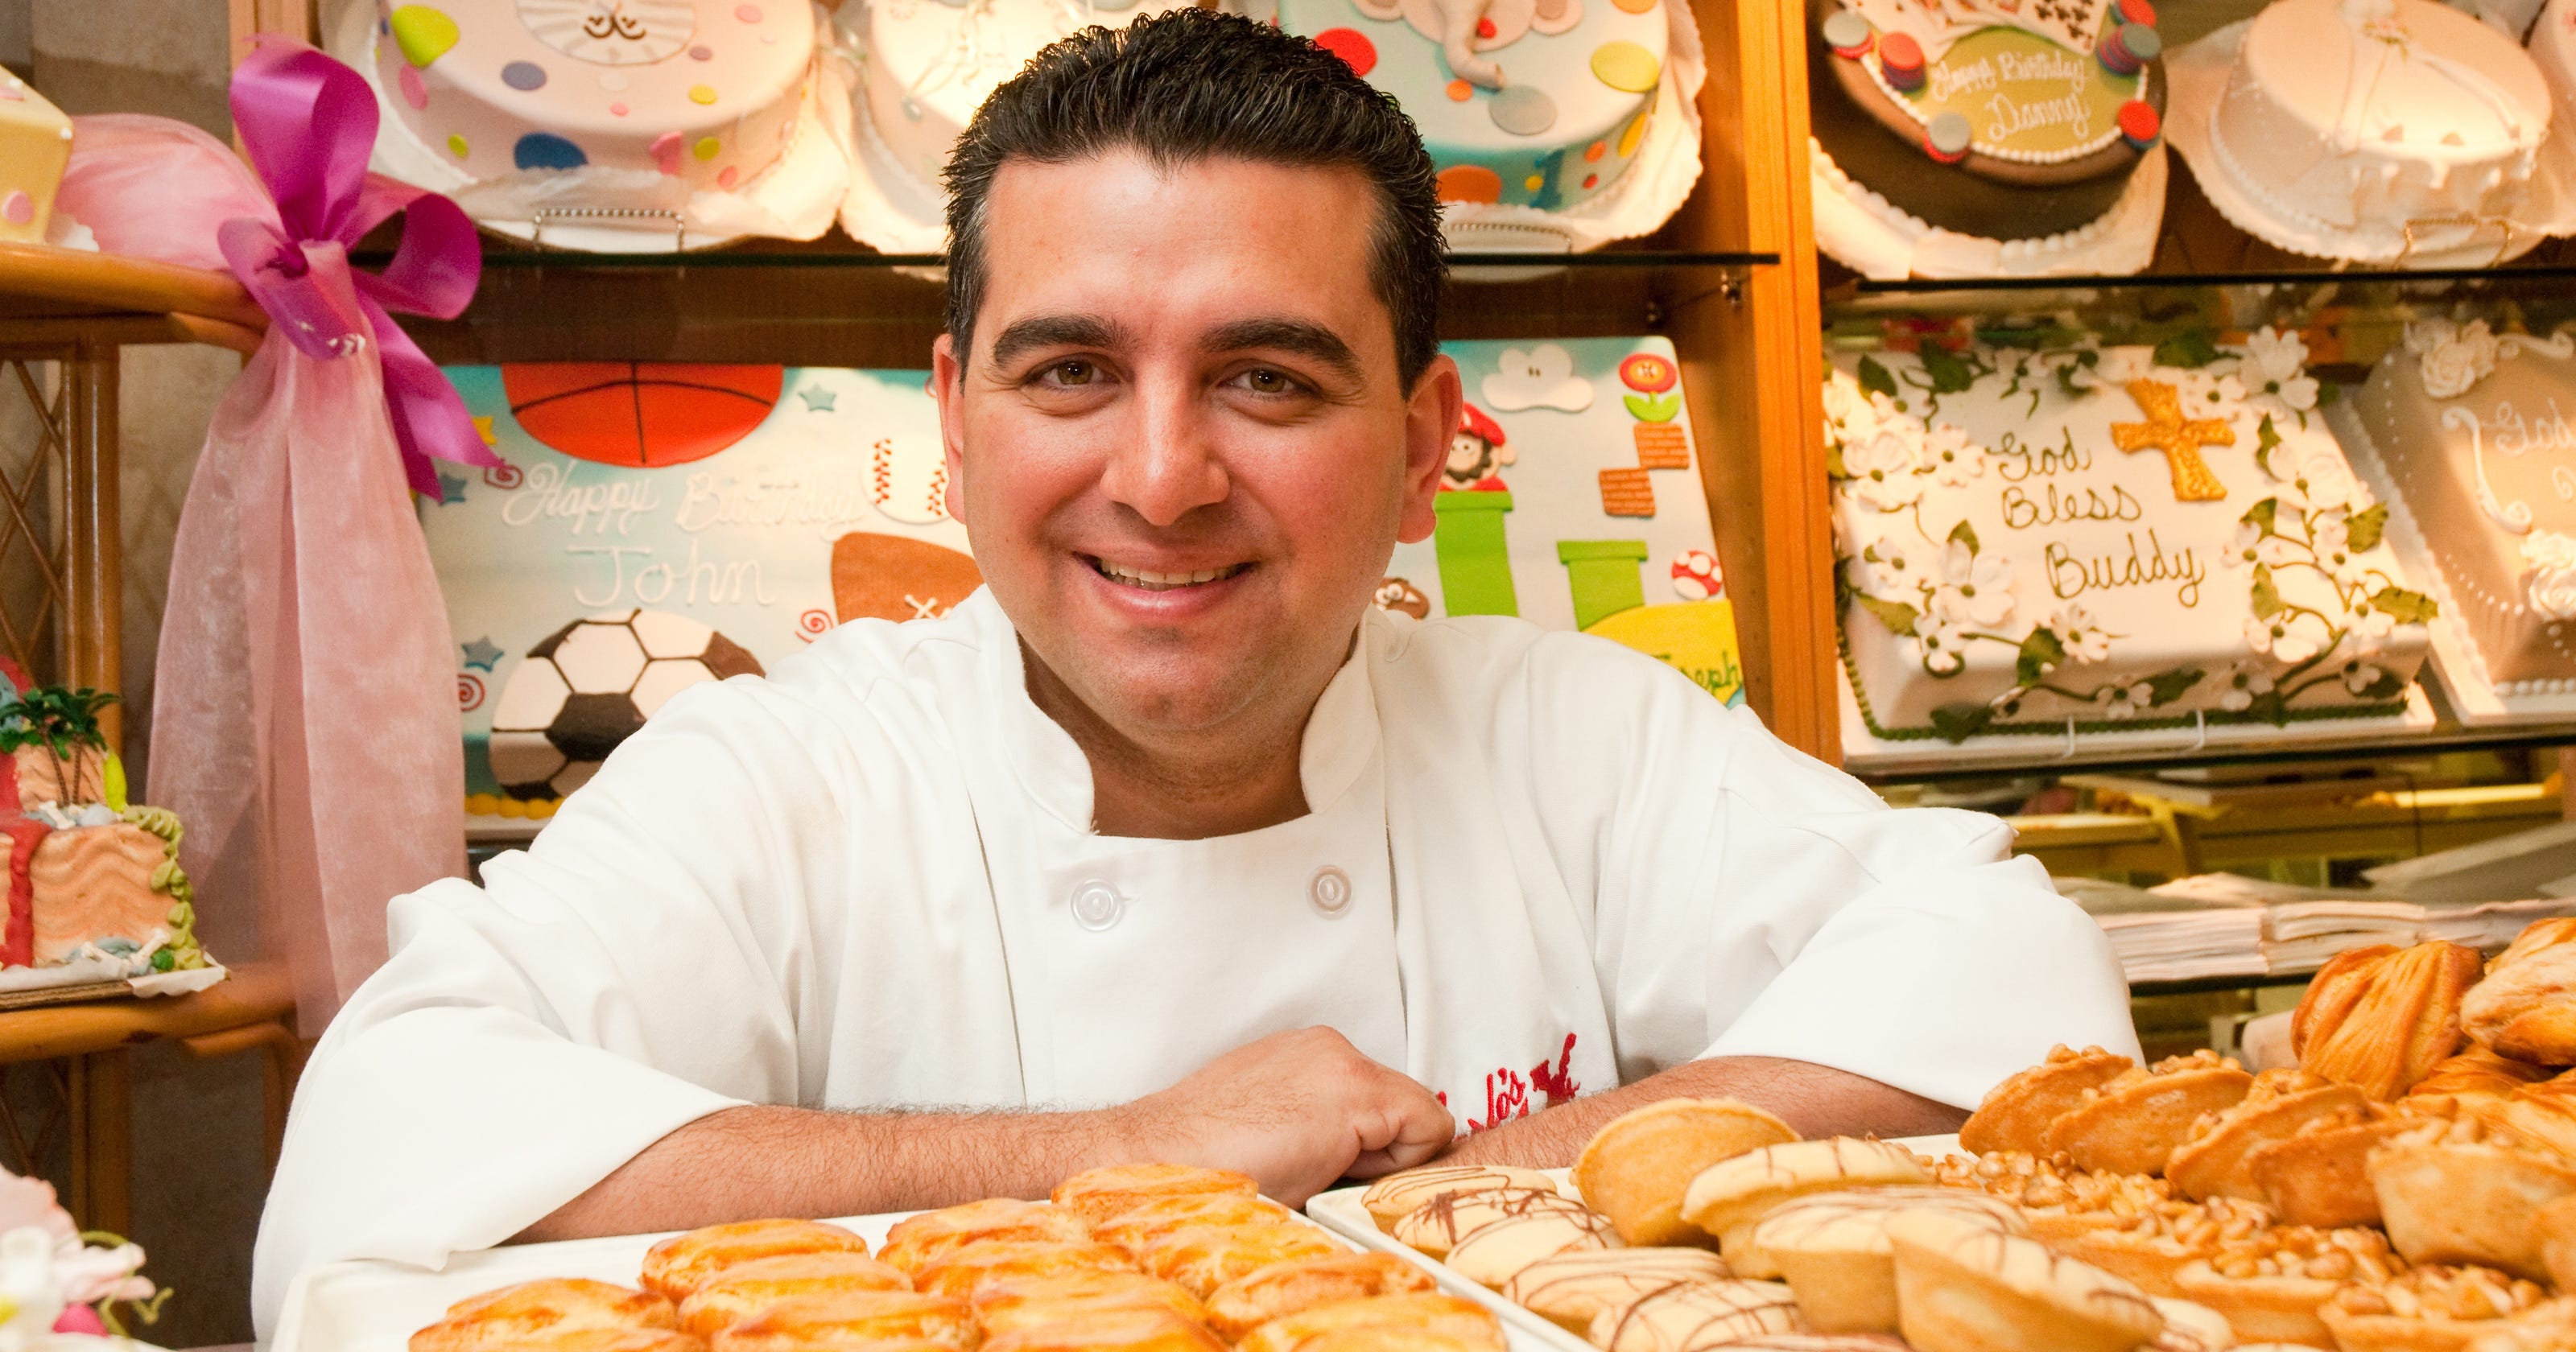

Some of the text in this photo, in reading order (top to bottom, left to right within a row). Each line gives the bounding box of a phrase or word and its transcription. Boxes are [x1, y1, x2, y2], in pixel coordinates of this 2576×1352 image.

[1997, 49, 2085, 95] Birthday
[1984, 92, 2091, 142] Danny
[1984, 426, 2092, 482] God
[502, 457, 868, 542] Happy Birthday
[2002, 482, 2142, 530] Bless
[566, 538, 776, 607] John
[2045, 526, 2206, 608] Buddy
